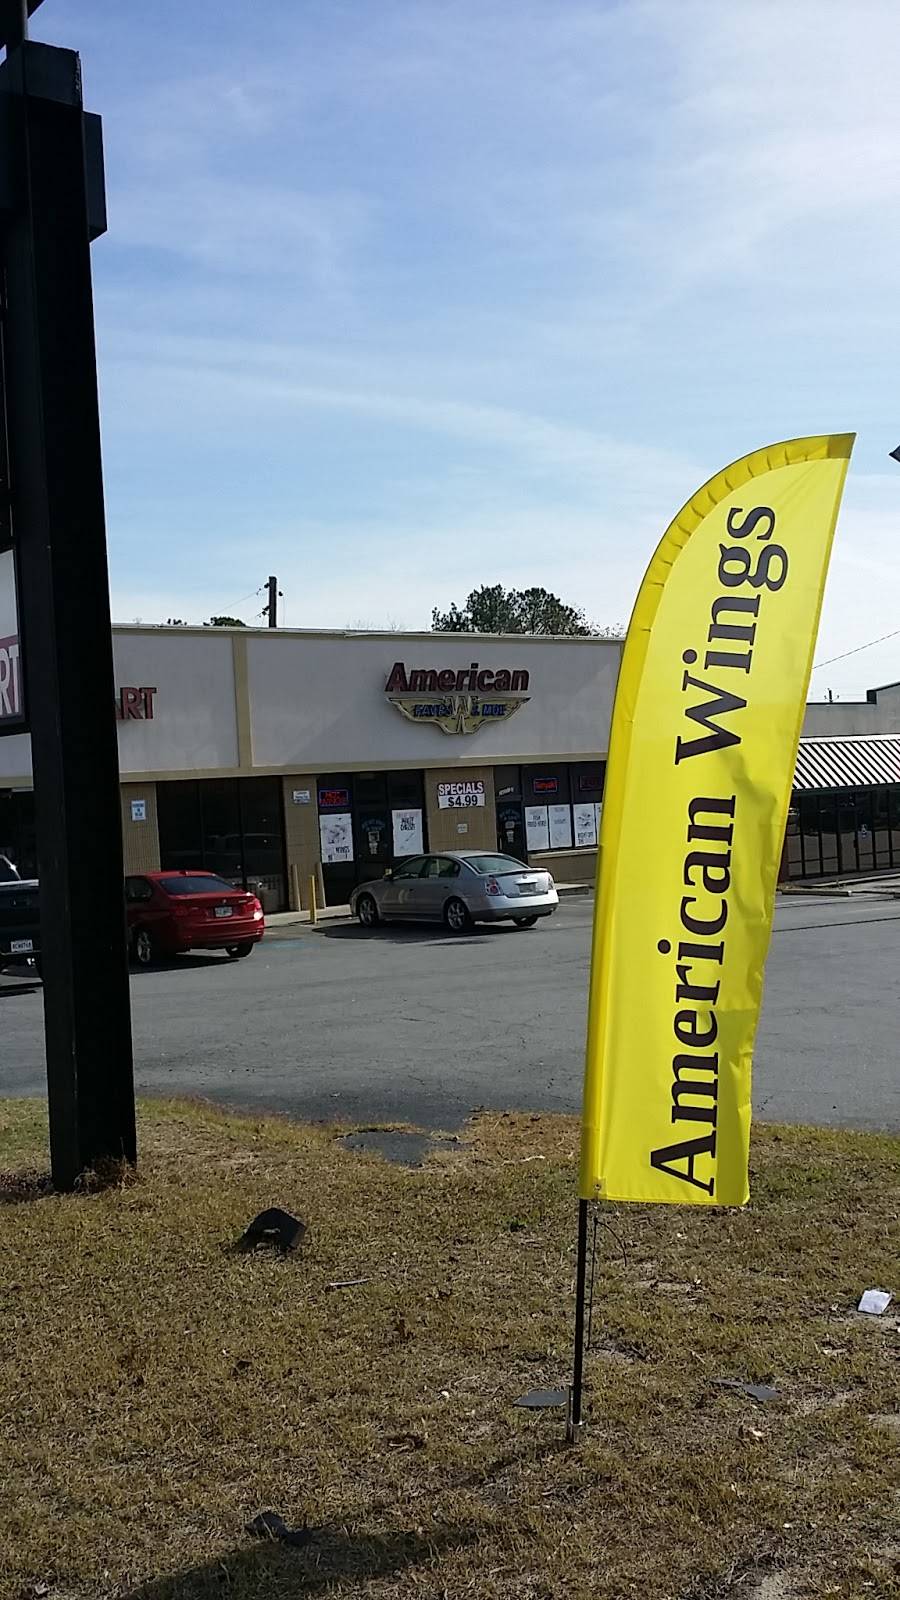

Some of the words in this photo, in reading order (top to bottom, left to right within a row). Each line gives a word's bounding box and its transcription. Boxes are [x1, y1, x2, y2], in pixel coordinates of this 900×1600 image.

[674, 505, 789, 766] Wings
[384, 662, 530, 692] American
[438, 782, 484, 795] SPECIALS
[448, 795, 478, 807] $4.99
[649, 795, 736, 1197] American
